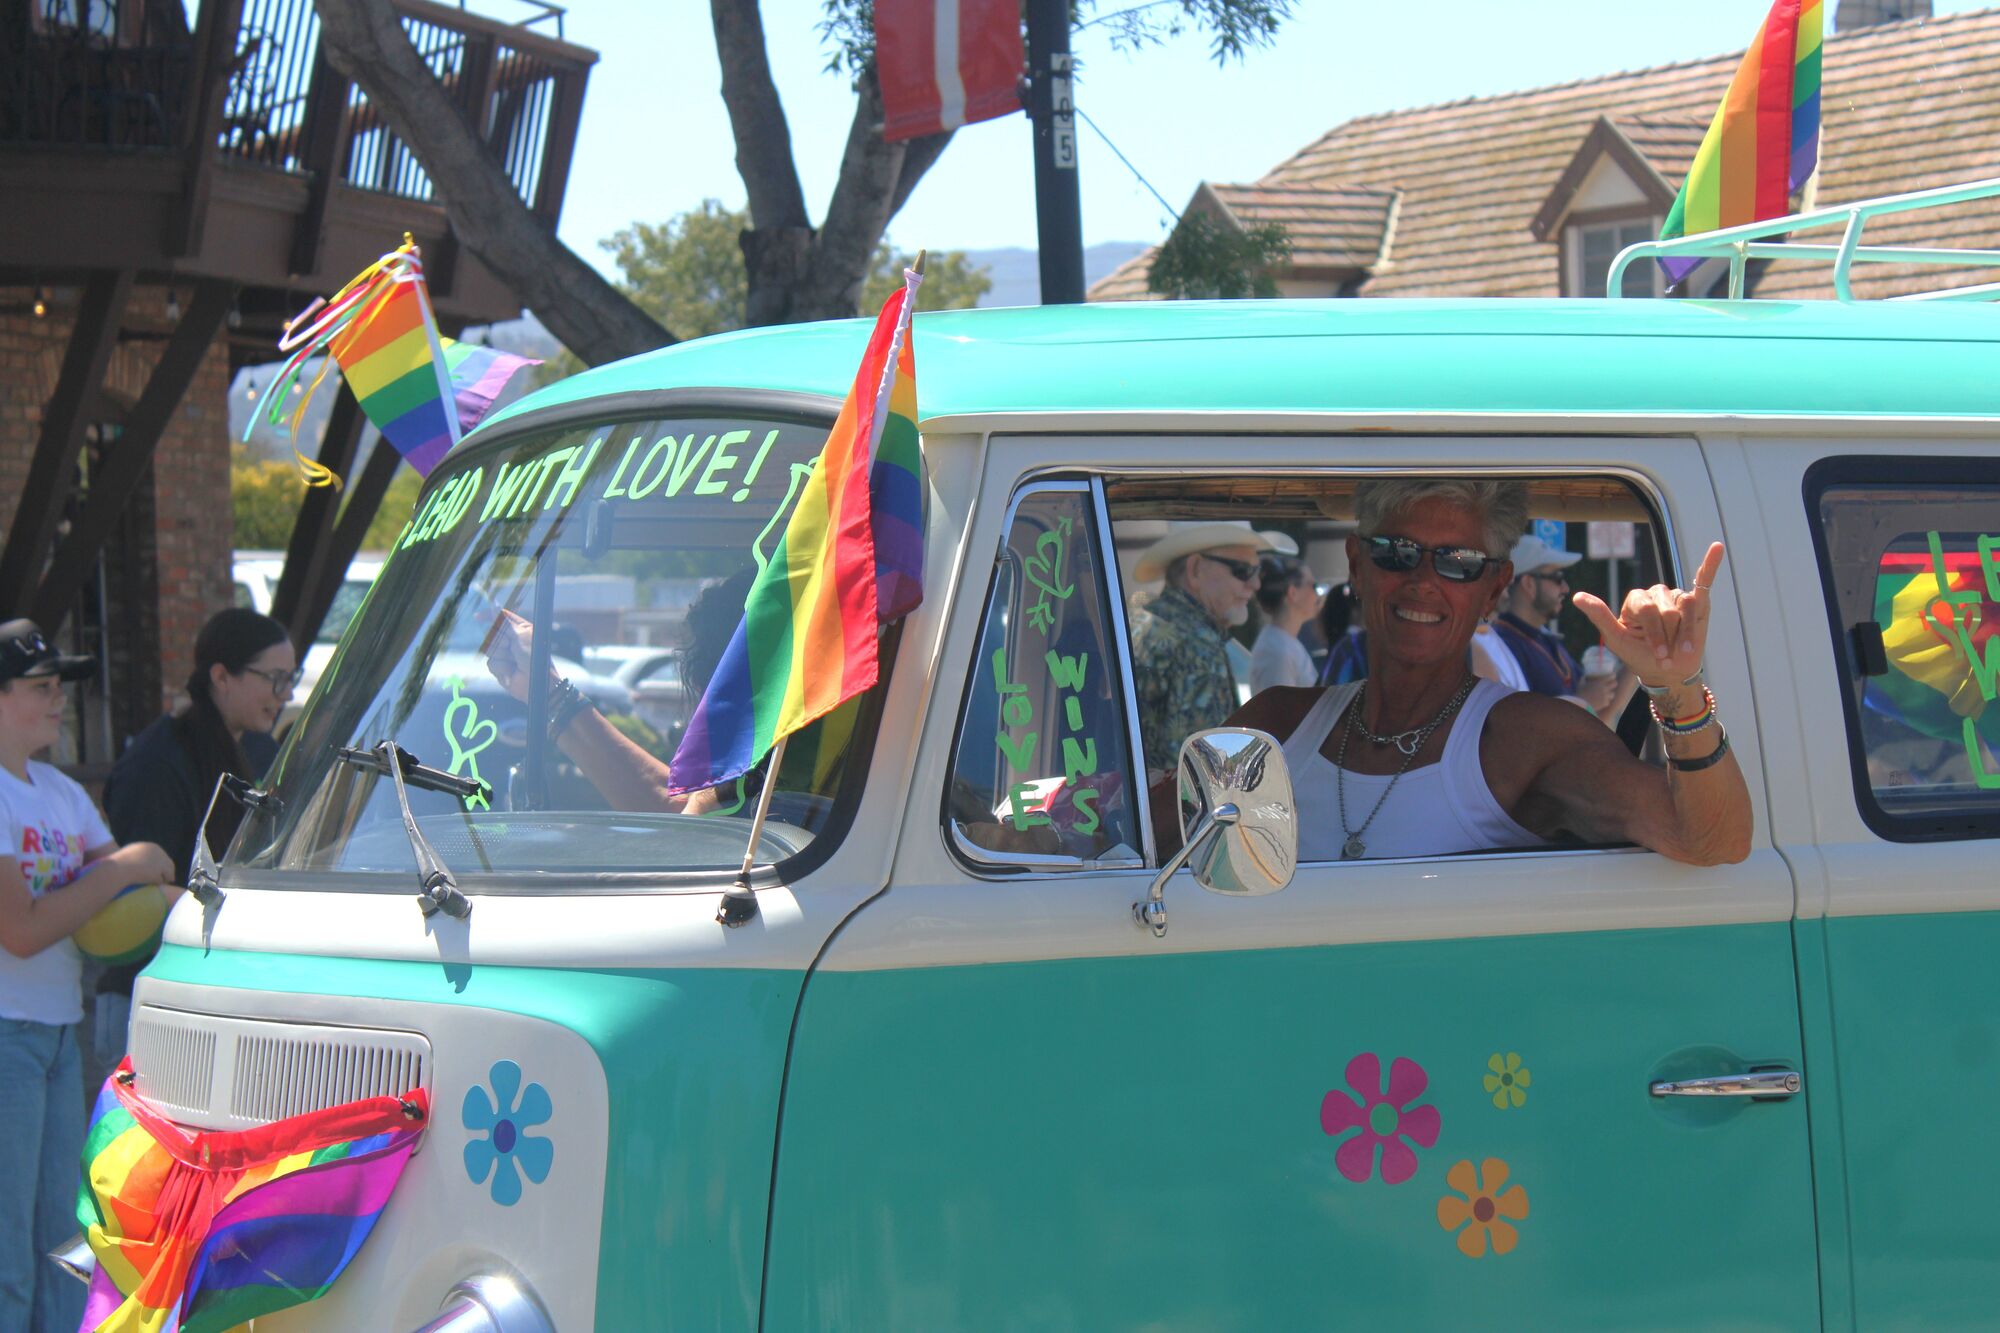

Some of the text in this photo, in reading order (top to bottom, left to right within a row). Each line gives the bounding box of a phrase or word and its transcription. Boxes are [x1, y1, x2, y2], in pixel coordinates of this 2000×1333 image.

[401, 429, 779, 550] LEAD WITH LOVE!
[991, 647, 1052, 832] LOVE
[1045, 649, 1100, 836] WINS
